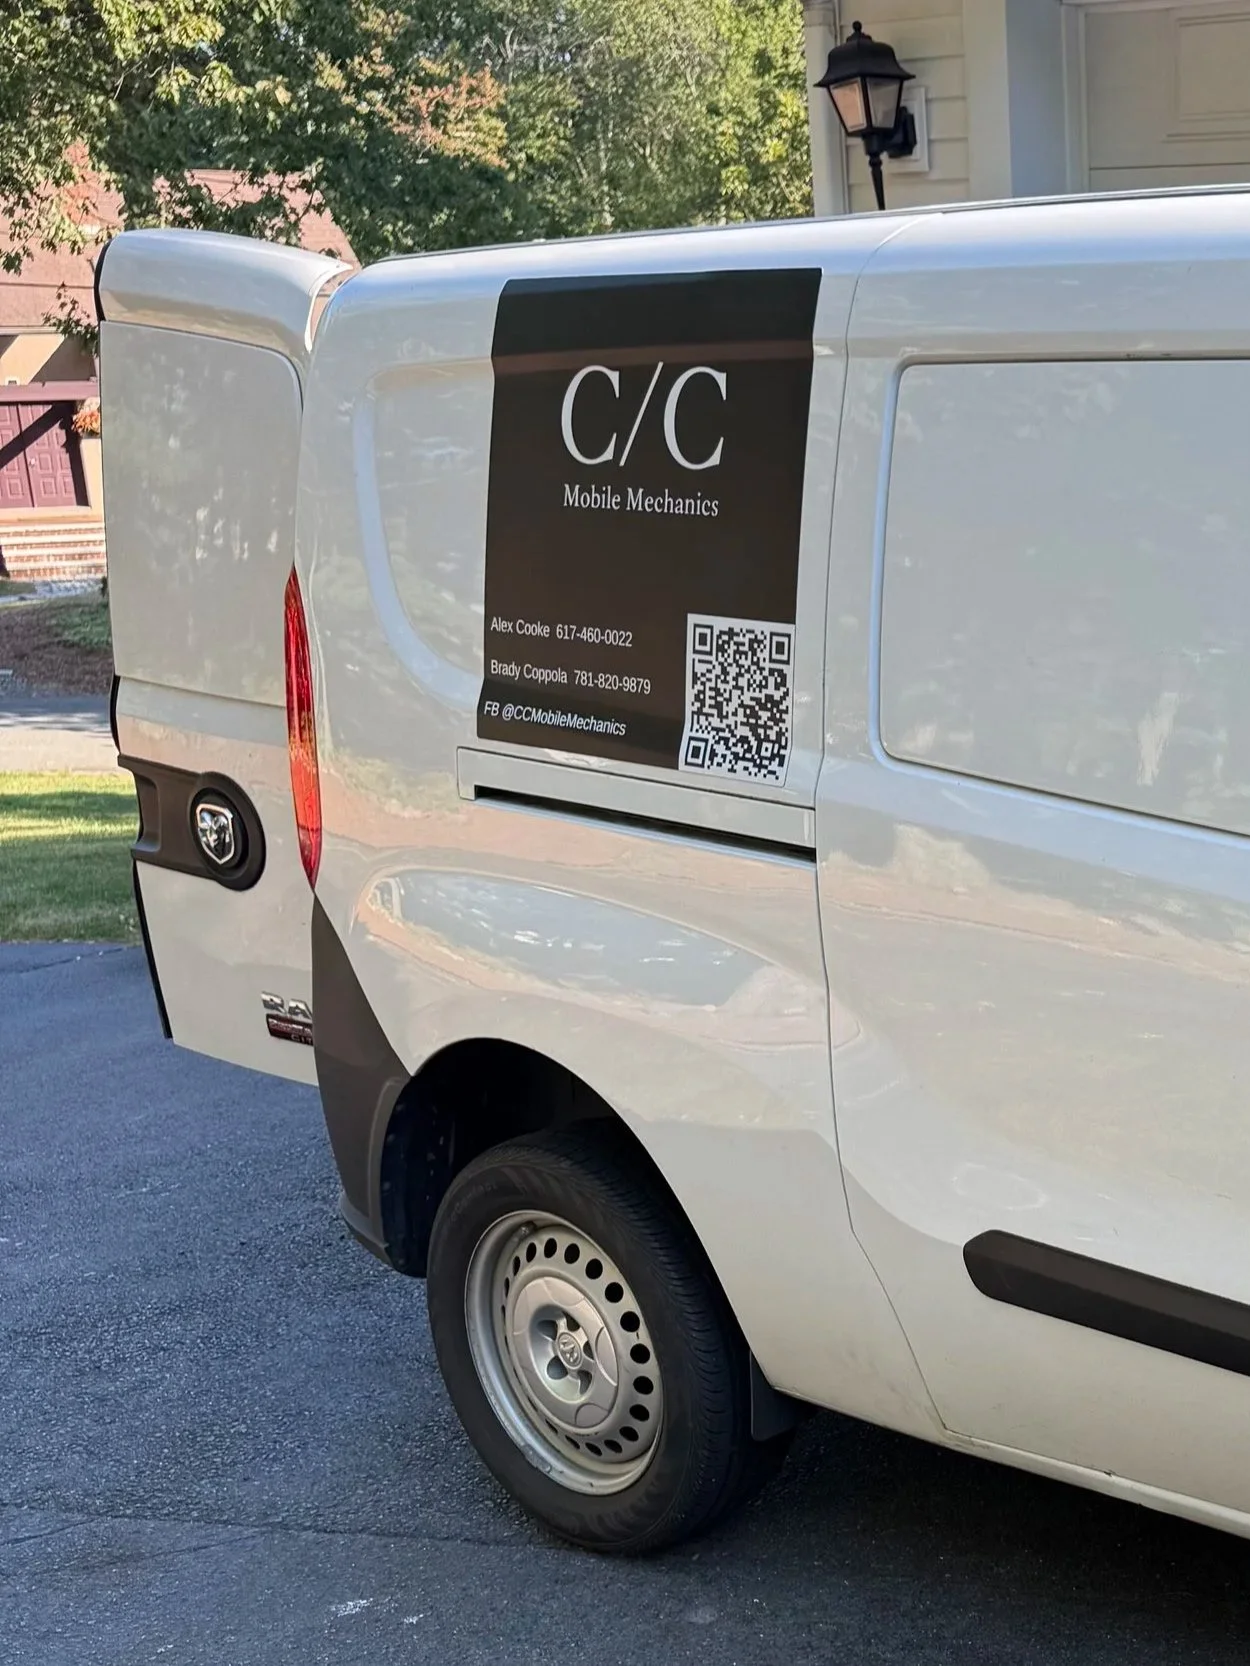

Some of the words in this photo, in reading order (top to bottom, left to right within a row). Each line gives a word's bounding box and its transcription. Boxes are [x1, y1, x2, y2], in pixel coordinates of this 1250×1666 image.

[561, 361, 727, 470] C/C
[563, 483, 621, 510] Mobile
[626, 487, 719, 516] Mechanics
[490, 616, 513, 633] Alex
[516, 619, 550, 638] Cooke
[556, 624, 633, 647] 617-460-0022
[490, 660, 521, 681] Brady
[523, 664, 568, 685] Coppola
[574, 670, 651, 695] 781-820-9879
[483, 701, 499, 717] FB
[502, 704, 627, 736] @CCMobileMechanics
[261, 991, 313, 1019] RA
[290, 1034, 312, 1045] CIT
